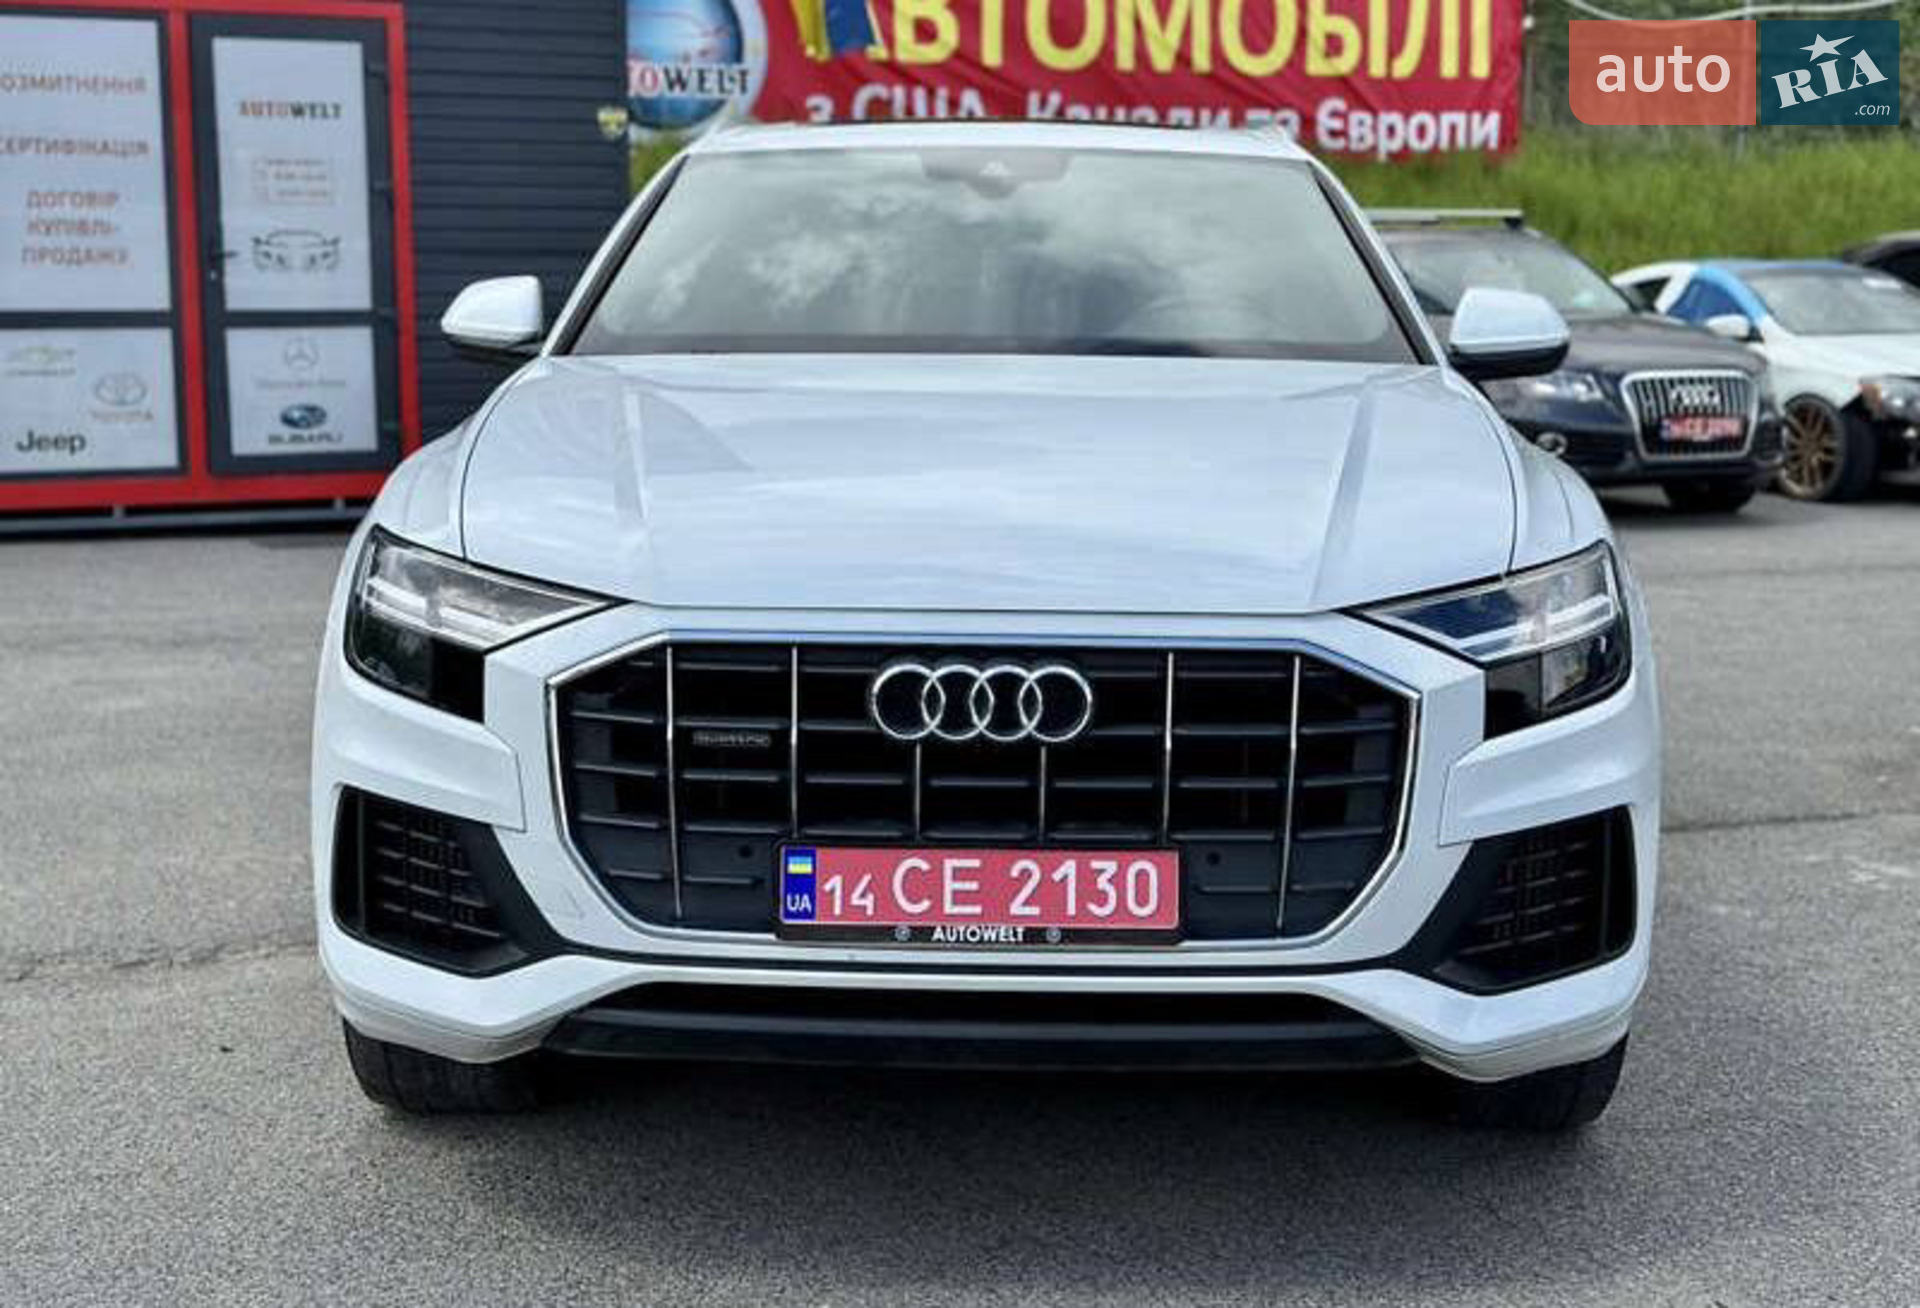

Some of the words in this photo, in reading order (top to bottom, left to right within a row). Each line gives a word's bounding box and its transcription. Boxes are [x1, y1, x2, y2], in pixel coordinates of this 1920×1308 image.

[0, 74, 147, 93] ОЗМИТНЕННЯ
[628, 66, 749, 96] OWELT
[239, 101, 342, 119] AUTOWELT
[1316, 98, 1500, 159] Європи
[27, 190, 119, 208] ДОГОВІР
[21, 246, 129, 266] ПРОДАЖУ
[16, 430, 87, 456] Jeep
[824, 873, 875, 917] 14
[892, 857, 983, 914] CE
[1009, 858, 1160, 917] 2130
[786, 893, 813, 914] UA
[931, 925, 1025, 943] AUTOWELT
